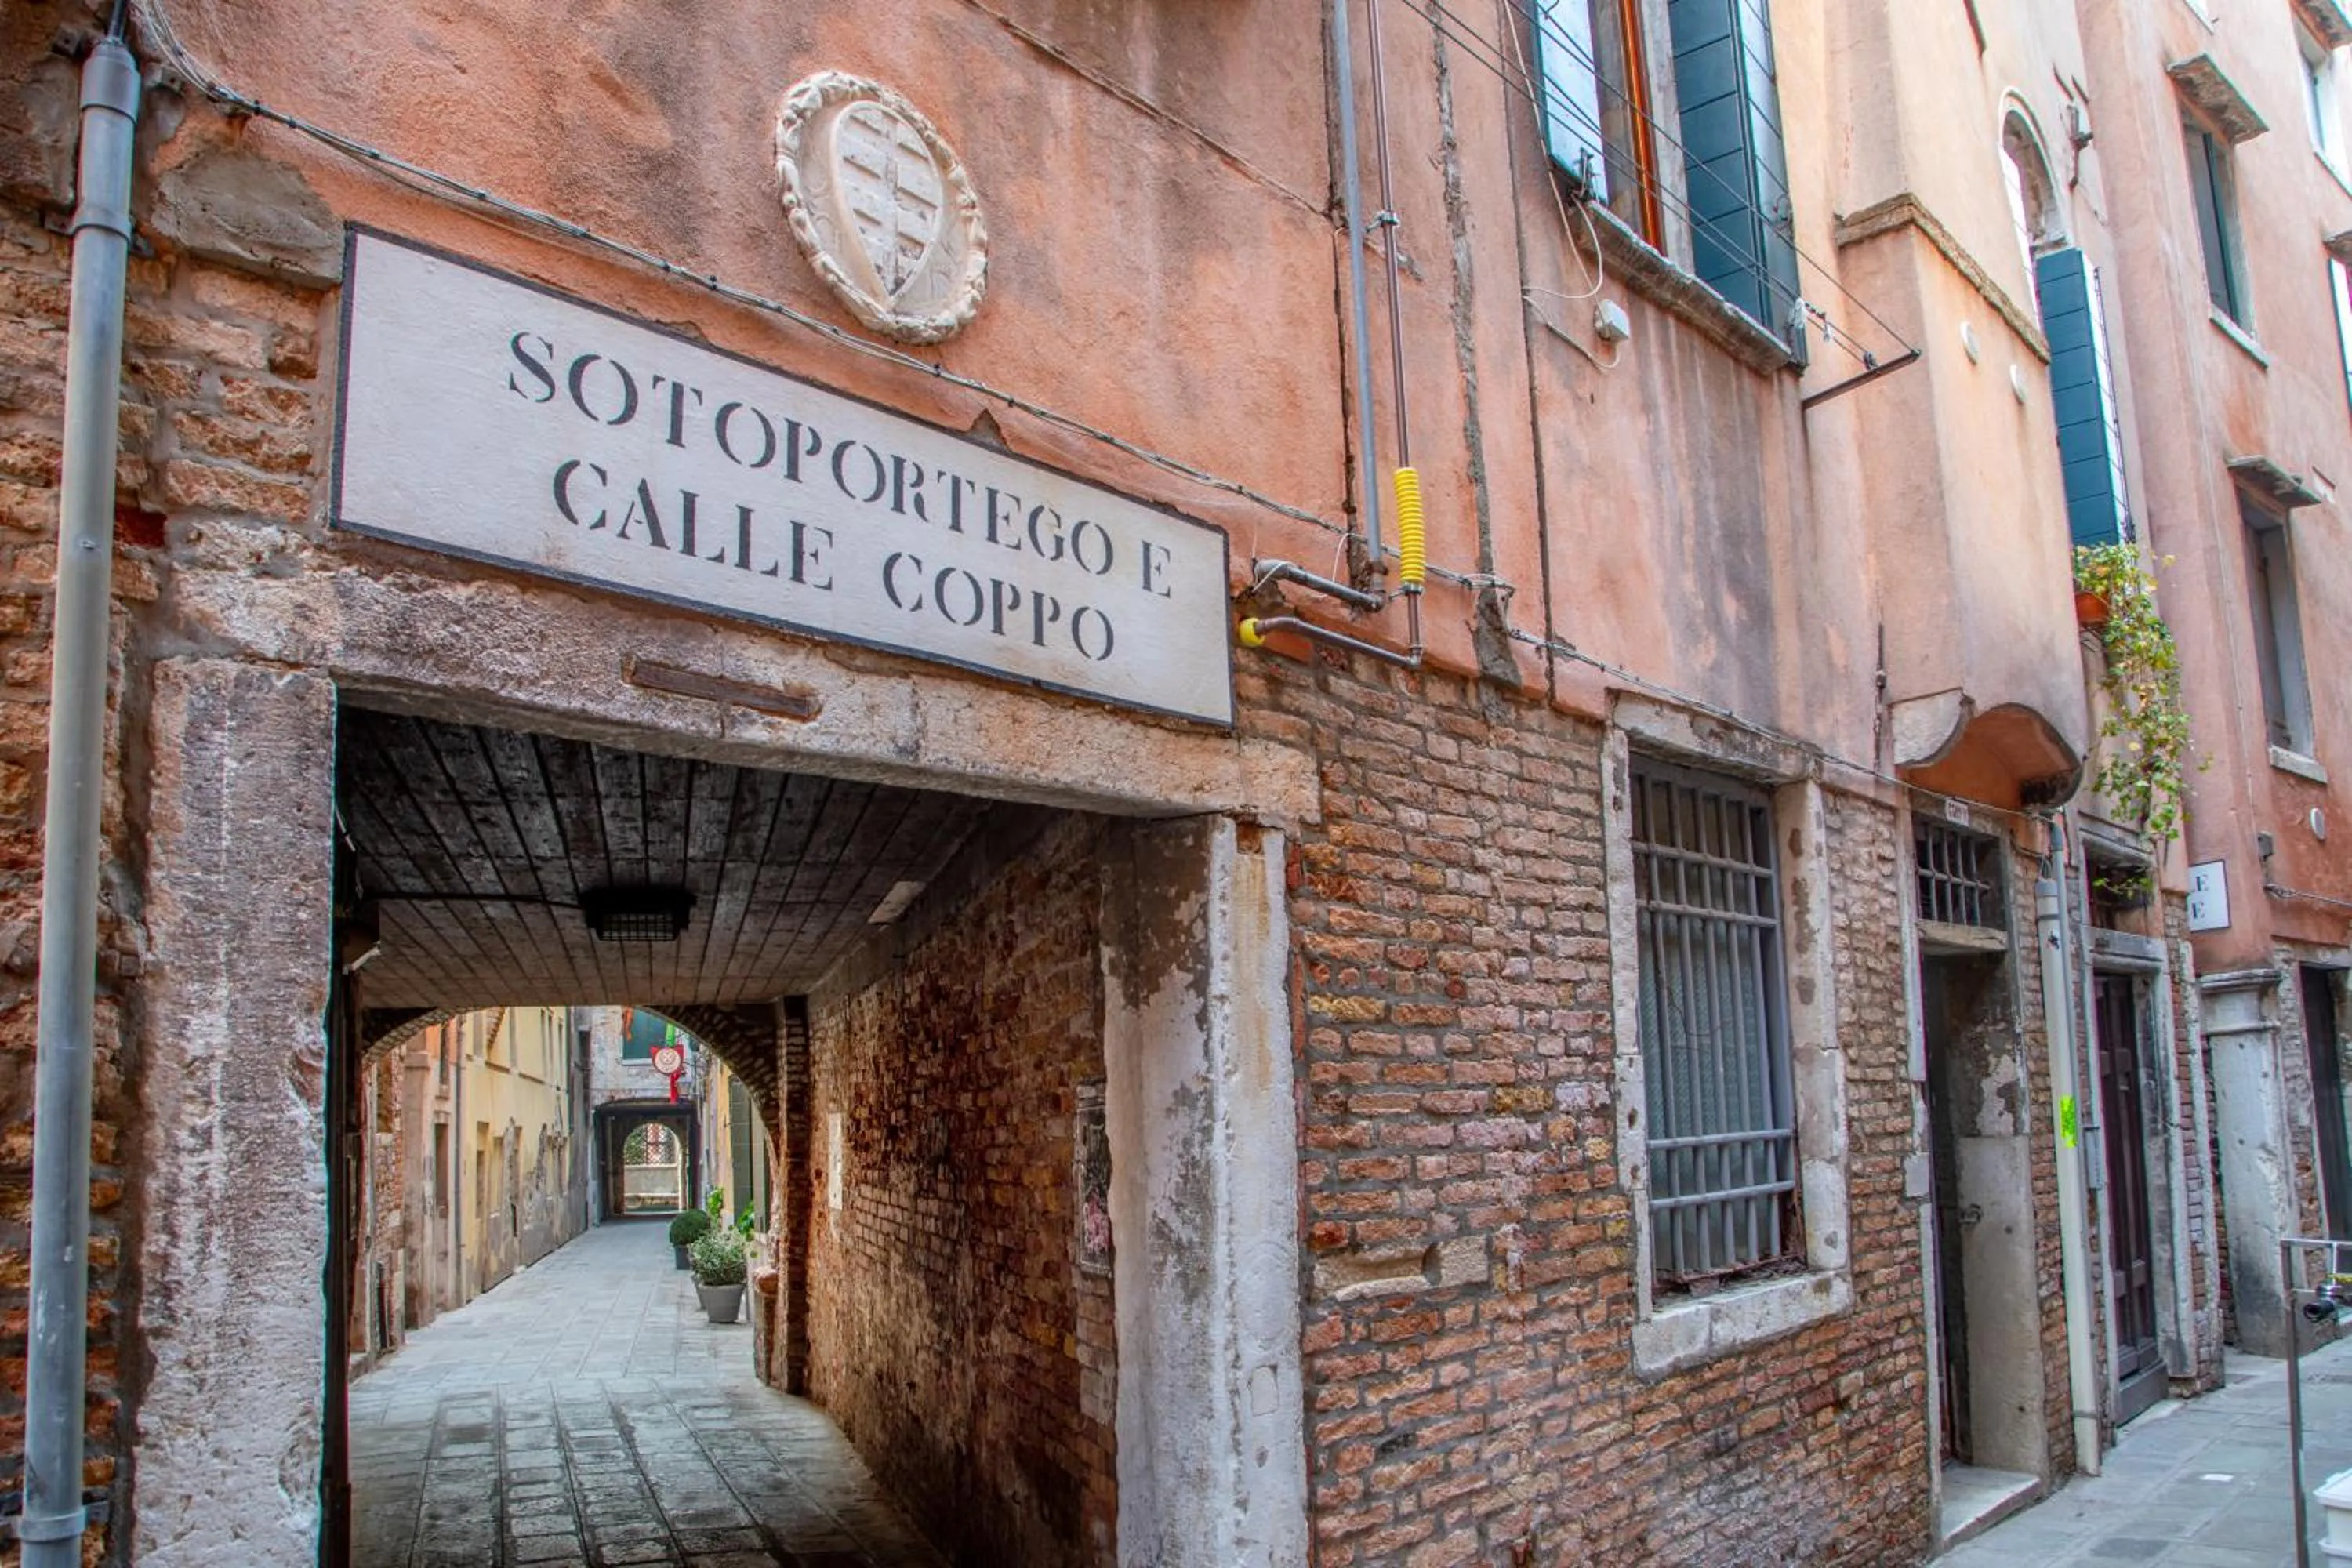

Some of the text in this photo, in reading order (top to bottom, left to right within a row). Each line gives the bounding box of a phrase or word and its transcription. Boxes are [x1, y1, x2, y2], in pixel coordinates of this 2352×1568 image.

[507, 331, 1171, 598] SOTOPORTEGO E
[552, 459, 1116, 662] CALLE COPPO
